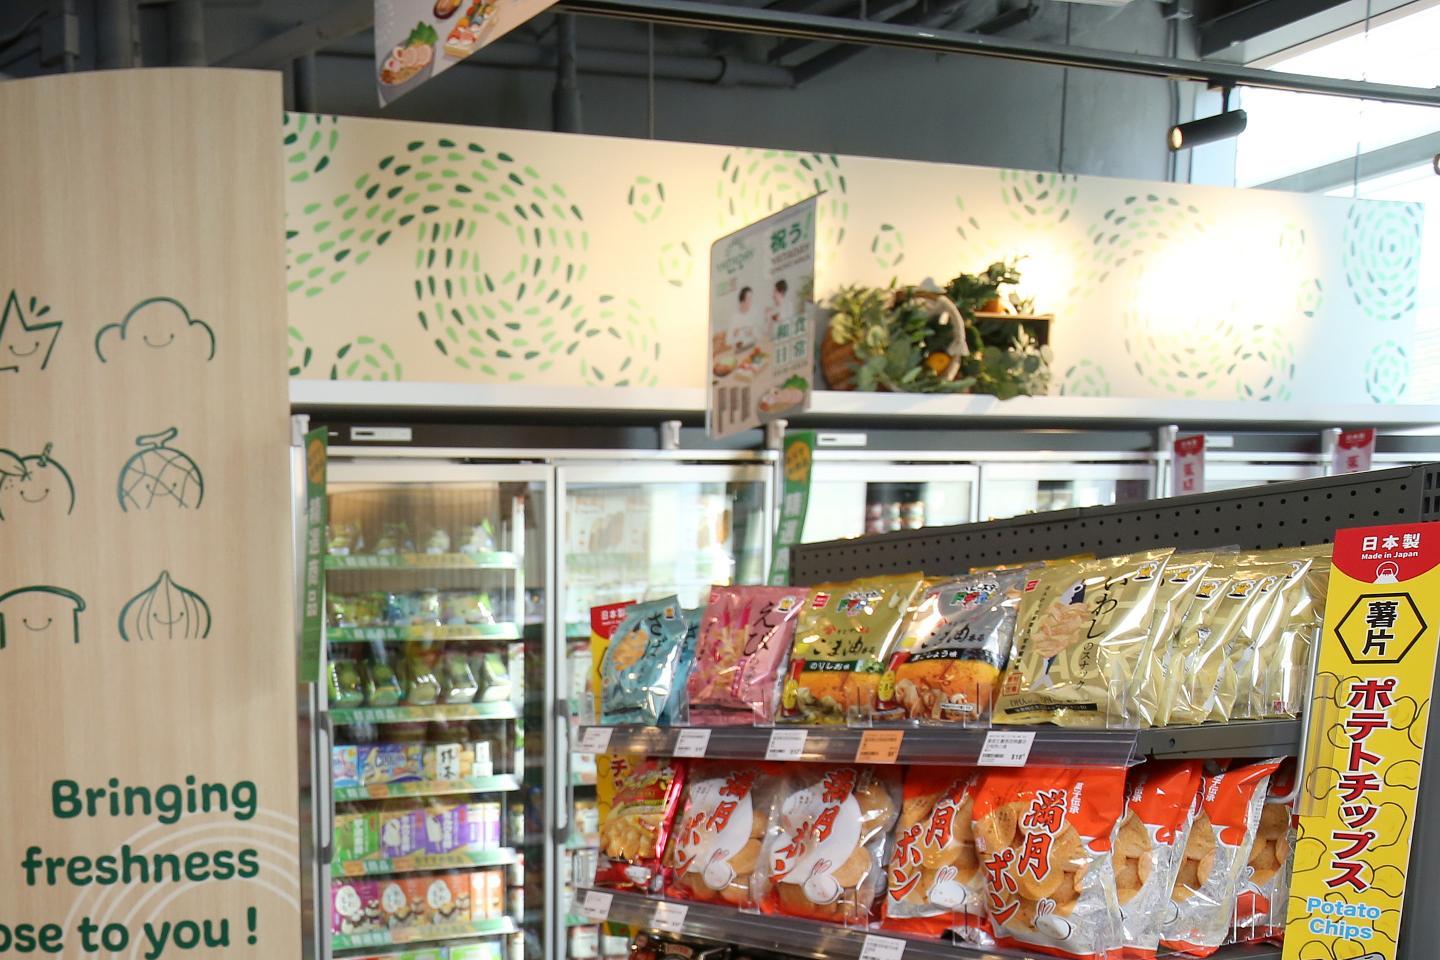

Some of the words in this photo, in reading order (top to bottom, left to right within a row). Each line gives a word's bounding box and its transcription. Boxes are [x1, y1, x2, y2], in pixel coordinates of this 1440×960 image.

[1361, 533, 1421, 551] 日本製
[1361, 552, 1381, 560] Made
[1393, 550, 1419, 558] Japan
[1362, 601, 1398, 657] 薯片
[51, 775, 257, 824] Bringing
[1326, 677, 1397, 893] ポテトチップス
[1018, 788, 1068, 881] 満月
[21, 844, 259, 886] freshness
[984, 847, 1018, 928] ポン
[1307, 898, 1380, 920] Potato
[78, 917, 129, 952] to
[143, 918, 229, 960] you
[1310, 918, 1373, 940] Chips
